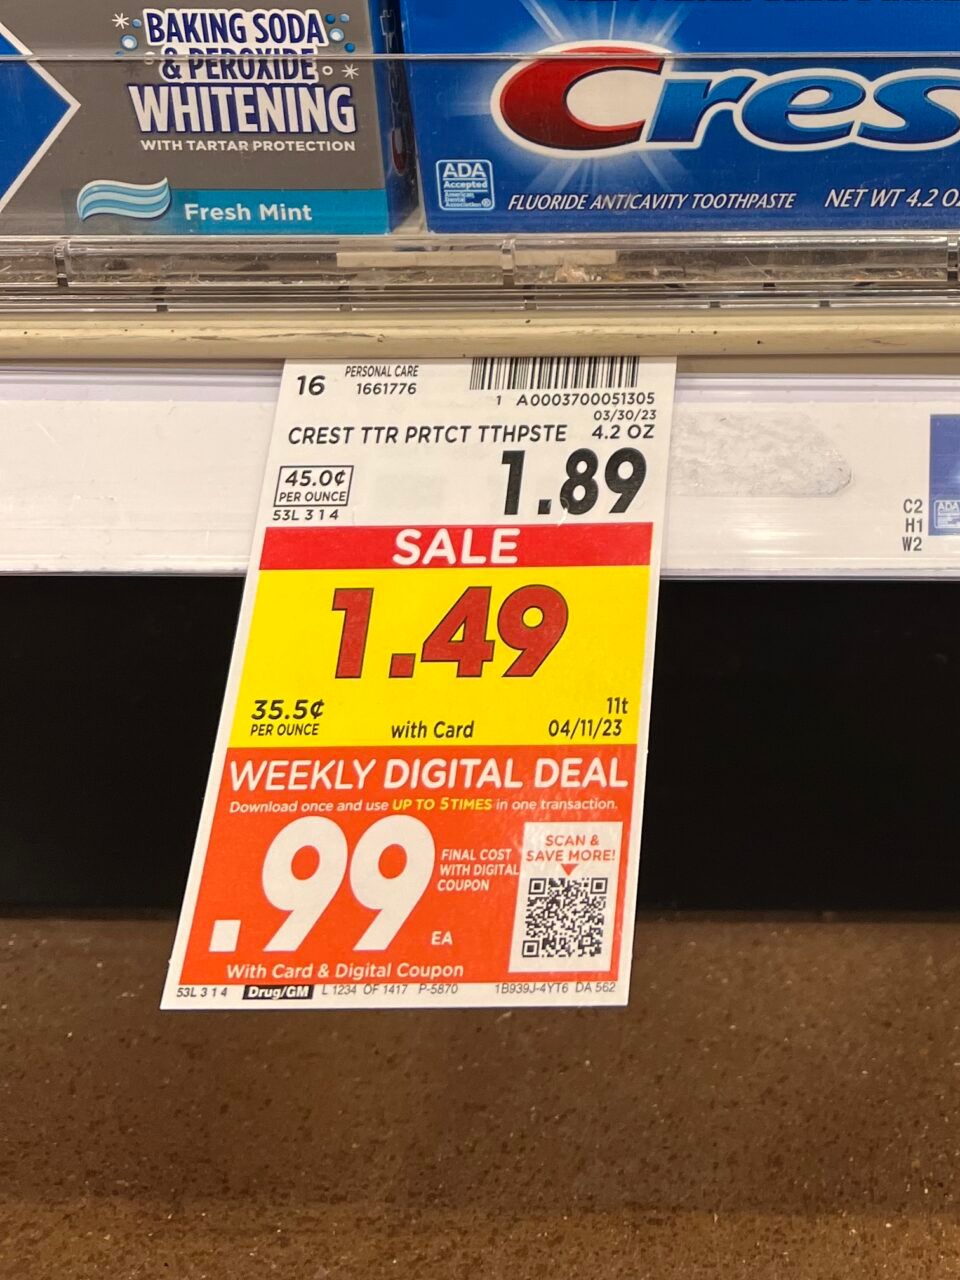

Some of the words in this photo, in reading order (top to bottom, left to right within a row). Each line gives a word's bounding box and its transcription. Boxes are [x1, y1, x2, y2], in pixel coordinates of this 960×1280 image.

[344, 364, 393, 378] PERSONAL
[394, 364, 419, 378] CARE
[296, 375, 326, 396] 16
[356, 383, 417, 395] 1661776
[516, 392, 655, 407] A0003700051305
[593, 409, 657, 422] 03/30/23
[288, 426, 355, 445] CREST
[360, 426, 398, 444] TTR
[405, 425, 471, 444] PRTCT
[478, 424, 568, 443] TTHPSTE
[592, 424, 620, 440] 4.2
[627, 424, 655, 440] OZ
[285, 469, 347, 488] 45.0¢
[501, 446, 647, 516] 1.89
[279, 491, 302, 503] PER
[304, 490, 347, 502] OUNCE
[903, 499, 923, 514] C2
[905, 519, 923, 533] H1
[392, 527, 521, 566] SALE
[902, 537, 922, 552] W2
[331, 584, 569, 679] 1.49
[251, 697, 325, 721] 35.5¢
[250, 723, 277, 737] PER
[278, 723, 320, 737] OUNCE
[391, 721, 430, 739] with
[433, 720, 474, 739] Card
[548, 718, 623, 739] 04/11/23
[228, 760, 378, 791] WEEKLY
[383, 758, 524, 790] DIGITAL
[533, 757, 628, 789] DEAL
[229, 799, 298, 814] Download
[300, 801, 334, 813] once
[337, 799, 362, 812] and
[365, 801, 389, 813] use
[392, 799, 412, 812] UP
[415, 799, 436, 811] TO
[496, 799, 508, 811] in
[512, 801, 537, 812] one
[540, 799, 618, 811] transaction.
[544, 834, 587, 847] SCAN
[590, 834, 600, 847] &
[441, 848, 479, 861] FINAL
[482, 848, 512, 861] COST
[526, 850, 565, 862] SAVE
[568, 849, 617, 862] MORE!
[439, 864, 471, 877] WITH
[474, 863, 521, 877] DIGITAL
[209, 814, 436, 953] .99
[437, 879, 490, 892] COUPON
[431, 931, 453, 946] EA
[226, 963, 268, 980] With
[271, 963, 317, 980] Card
[318, 964, 332, 979] &
[335, 962, 394, 981] Digital
[397, 962, 465, 982] Coupon
[247, 985, 310, 999] Drug/GM
[418, 984, 459, 994] P-5870
[575, 982, 592, 993] DA
[595, 982, 616, 993] 562
